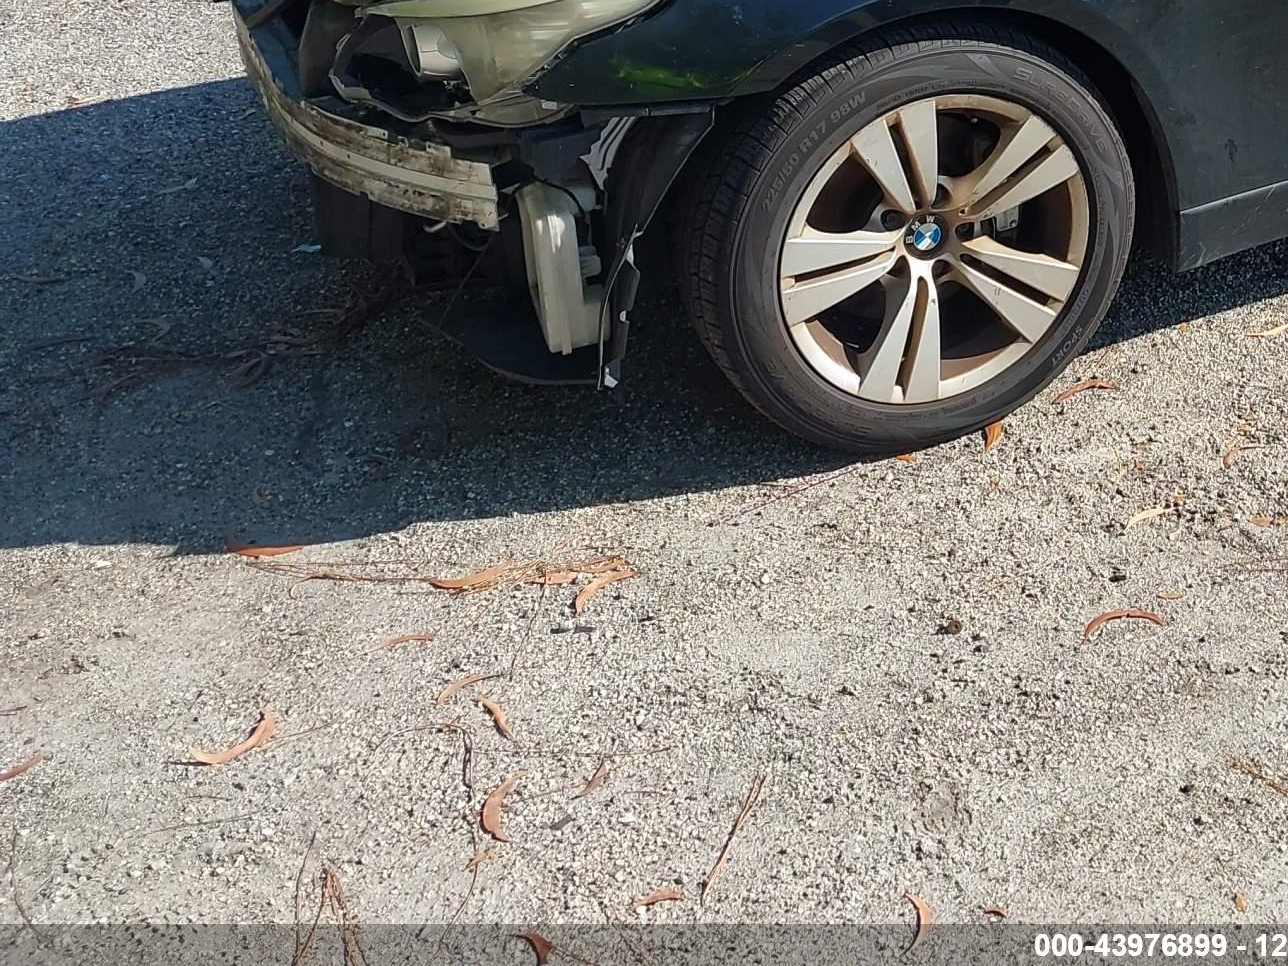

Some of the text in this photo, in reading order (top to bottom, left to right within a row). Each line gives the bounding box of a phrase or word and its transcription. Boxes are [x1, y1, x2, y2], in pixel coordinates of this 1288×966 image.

[761, 92, 866, 212] 225/50 R17 98W
